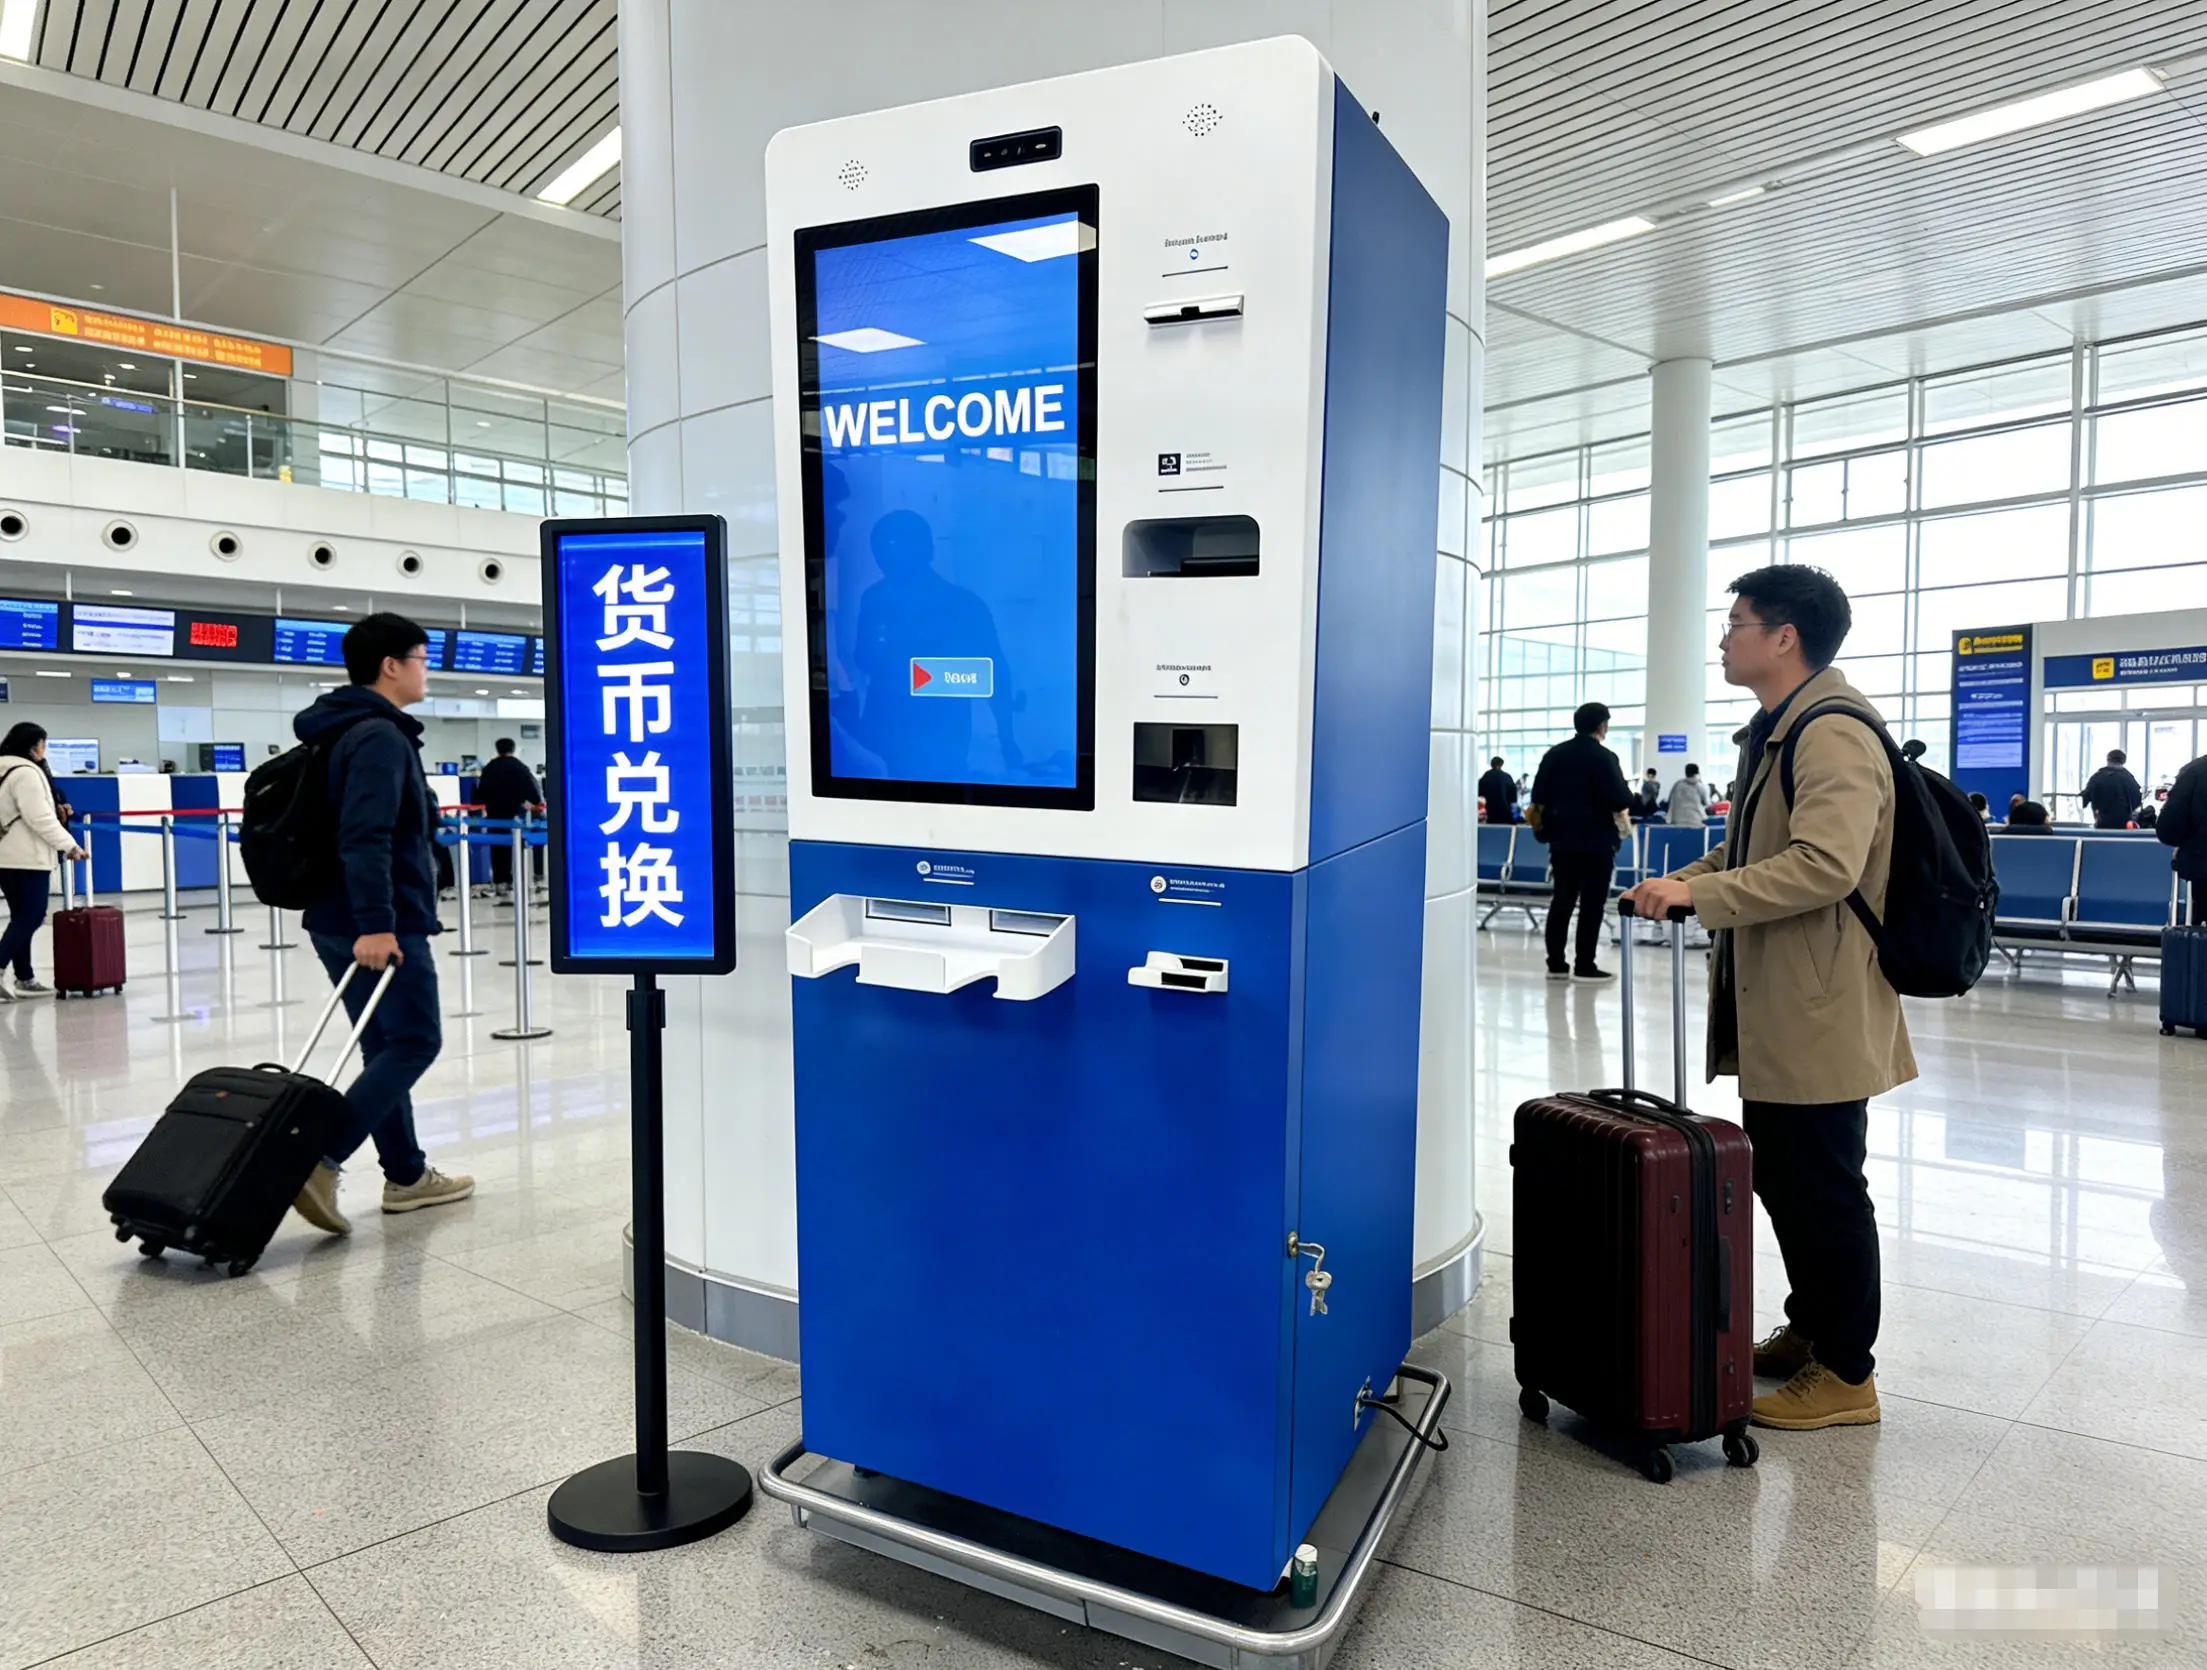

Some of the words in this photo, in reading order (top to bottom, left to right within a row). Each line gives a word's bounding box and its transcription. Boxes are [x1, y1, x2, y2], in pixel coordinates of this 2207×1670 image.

[824, 384, 1065, 448] WELCOME
[592, 563, 685, 929] 货币兑换
